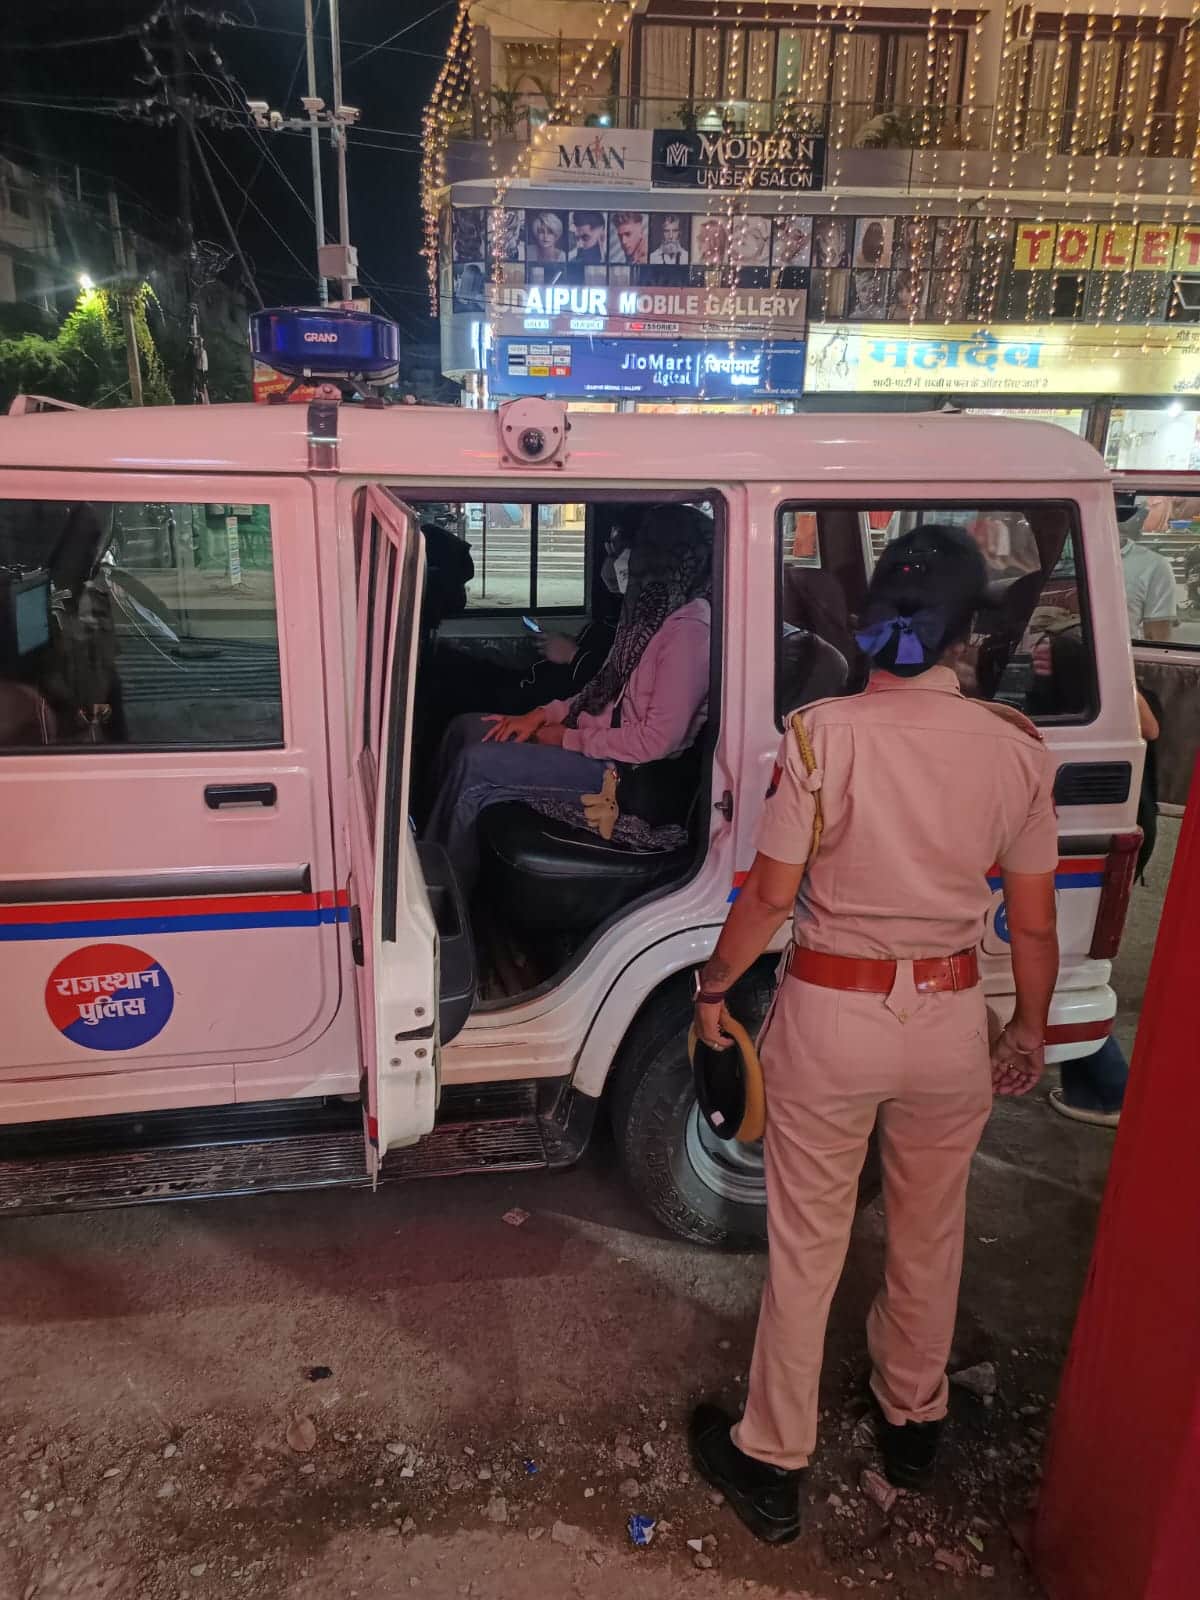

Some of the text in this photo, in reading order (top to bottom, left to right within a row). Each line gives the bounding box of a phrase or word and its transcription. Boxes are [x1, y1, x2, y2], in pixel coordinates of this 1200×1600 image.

[697, 133, 815, 167] MODERN
[759, 171, 813, 188] SALON
[493, 287, 800, 316] UDAIPUR MOBILE GALLERY
[304, 332, 338, 342] GRAND
[622, 354, 692, 370] JioMart
[653, 373, 690, 386] digital
[54, 969, 160, 996] राजस्थान
[77, 996, 146, 1025] पुलिस
